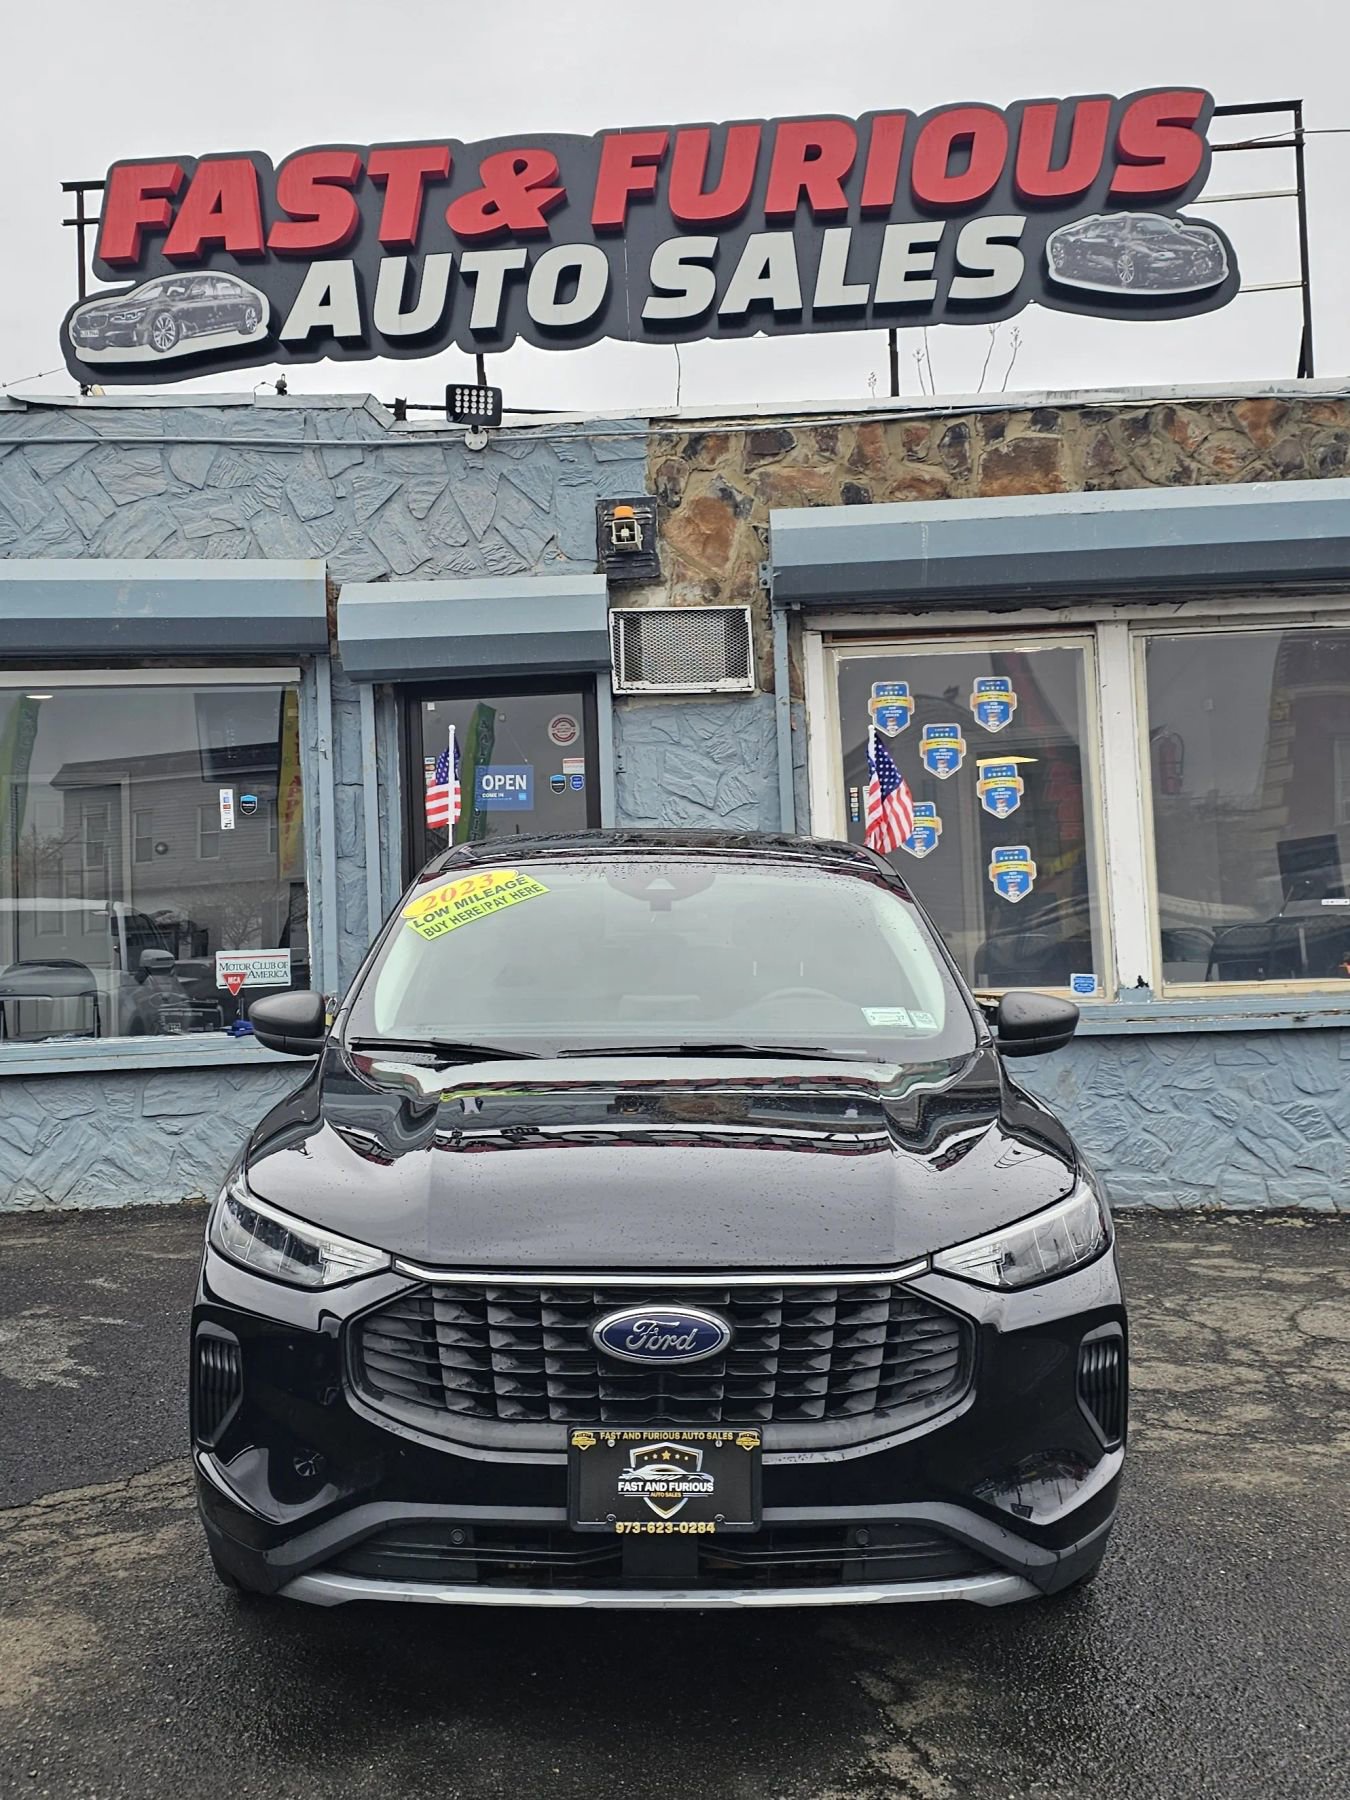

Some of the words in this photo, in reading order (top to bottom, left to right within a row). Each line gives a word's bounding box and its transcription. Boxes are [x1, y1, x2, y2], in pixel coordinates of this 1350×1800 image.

[100, 145, 453, 266] FAST
[445, 147, 567, 241] &
[591, 88, 1207, 232] FURIOUS
[279, 242, 609, 343] AUTO
[641, 215, 1027, 322] SALES
[482, 774, 527, 790] OPEN
[413, 906, 450, 928] LOW
[454, 876, 529, 910] MILEAGE
[423, 873, 494, 912] 2023
[423, 922, 449, 937] BUY
[509, 884, 544, 899] HERE
[277, 961, 288, 969] OF
[625, 1319, 699, 1351] Ford
[600, 1432, 621, 1440] FAST
[623, 1432, 641, 1440] AND
[642, 1432, 681, 1440] FURIOUS
[682, 1432, 706, 1440] AUTO
[707, 1432, 734, 1440] SALES
[618, 1482, 644, 1492] FAST
[645, 1482, 667, 1492] AND
[669, 1482, 714, 1492] FURIOUS
[615, 1522, 716, 1534] 973-623-0284
